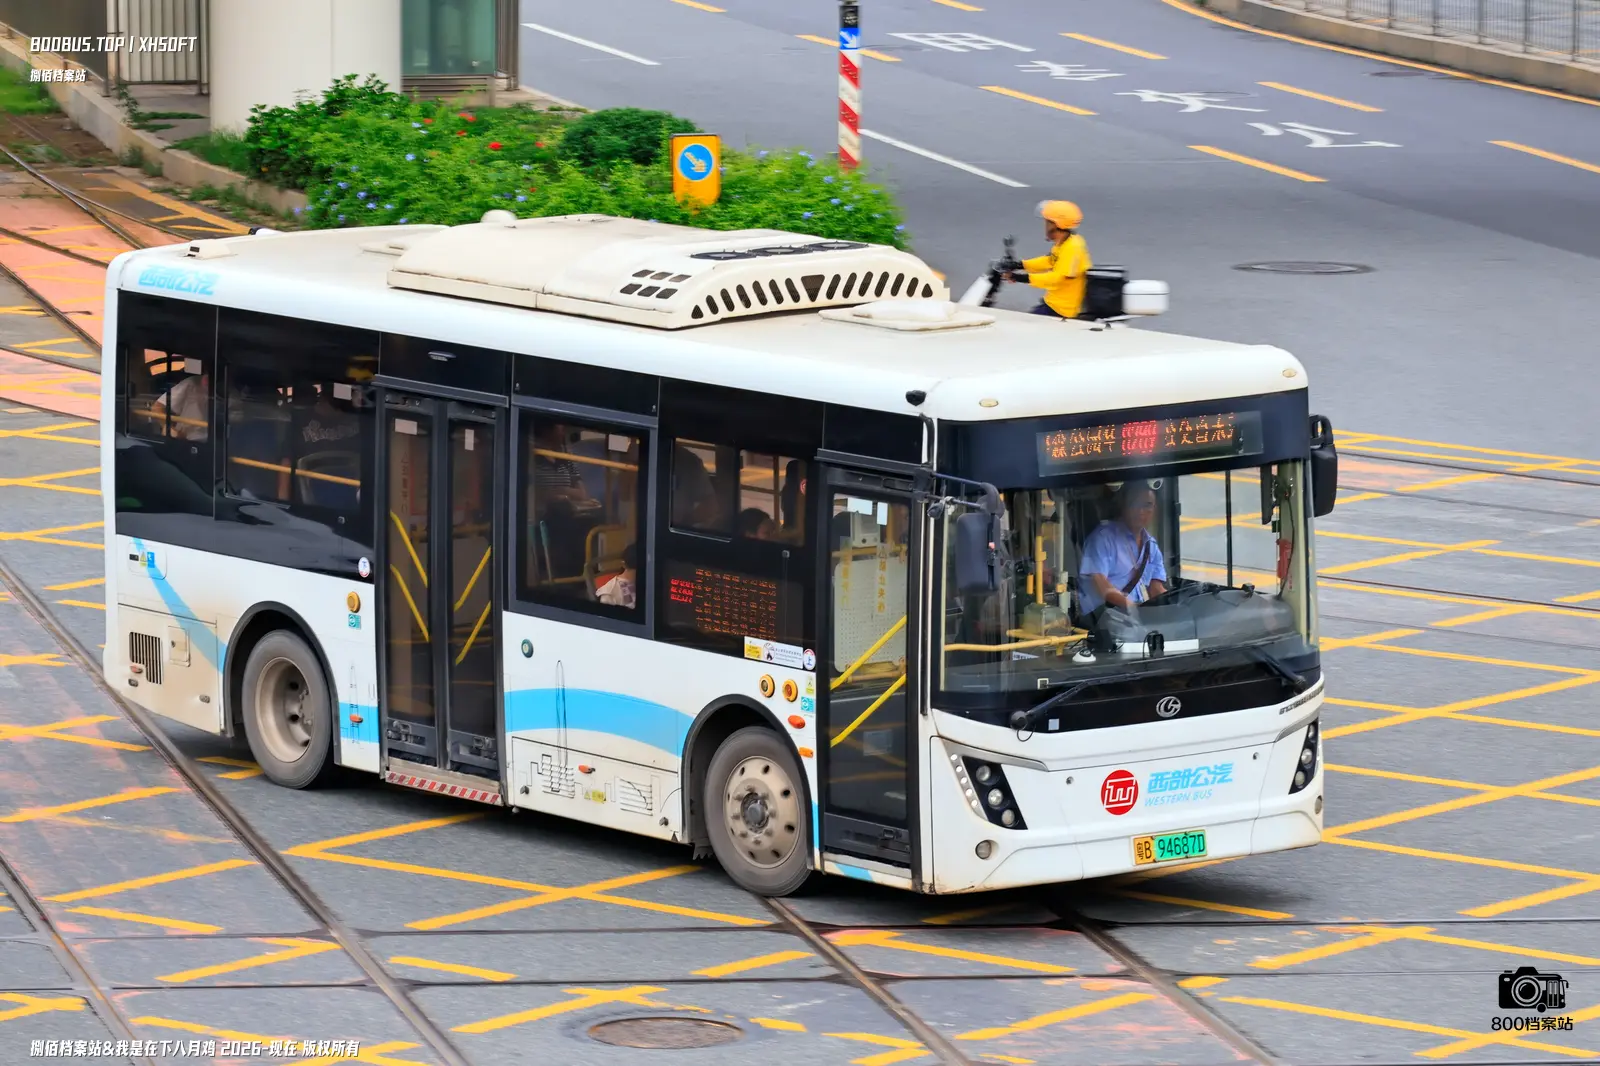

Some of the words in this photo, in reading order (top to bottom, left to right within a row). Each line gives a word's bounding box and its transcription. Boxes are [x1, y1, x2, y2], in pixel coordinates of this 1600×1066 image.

[1148, 763, 1233, 790] 西部公汽
[1144, 792, 1191, 807] WESTERN
[1192, 788, 1213, 801] BUS
[1158, 834, 1205, 858] 94687D
